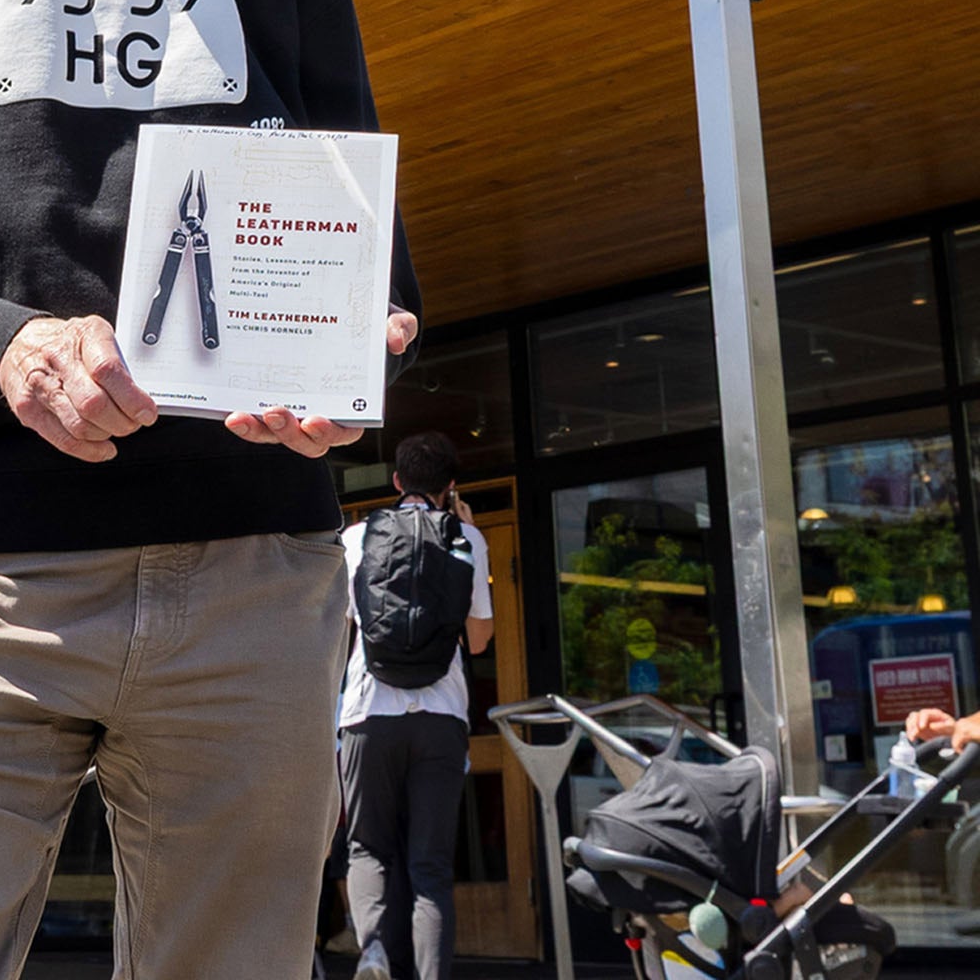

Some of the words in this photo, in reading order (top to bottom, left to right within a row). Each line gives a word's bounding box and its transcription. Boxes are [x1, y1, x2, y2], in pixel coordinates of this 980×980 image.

[65, 30, 162, 88] HG
[238, 202, 272, 213] THE
[236, 218, 358, 233] LEATHERMAN
[235, 234, 284, 246] BOOK
[229, 290, 268, 298] Multi-Tool
[228, 310, 250, 319] TIM
[254, 312, 338, 324] LEATHERMAN
[242, 324, 268, 332] CHRIS
[271, 326, 313, 335] KORNELIS
